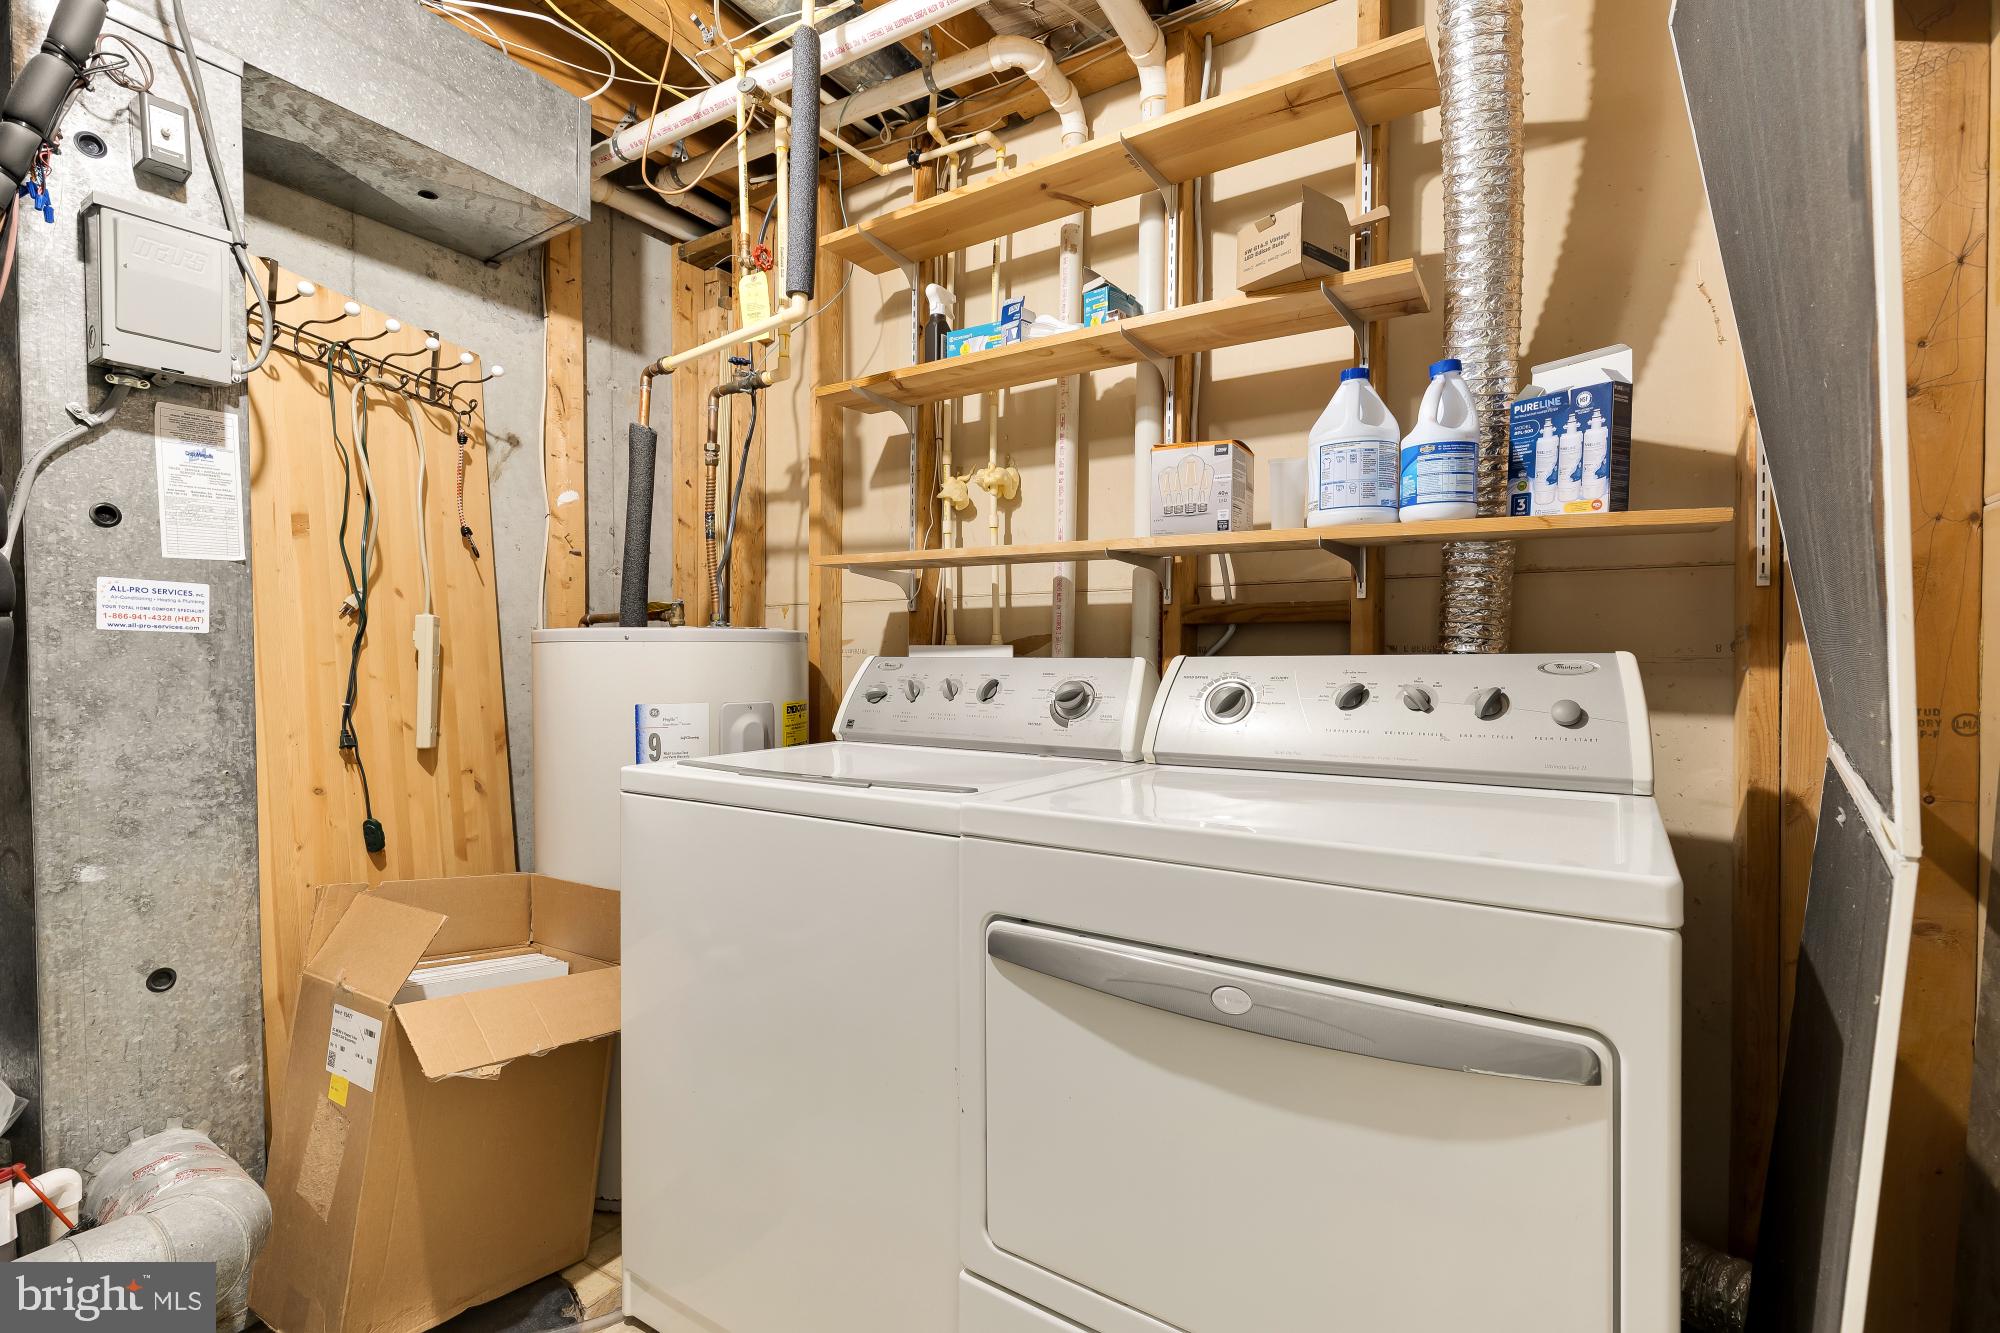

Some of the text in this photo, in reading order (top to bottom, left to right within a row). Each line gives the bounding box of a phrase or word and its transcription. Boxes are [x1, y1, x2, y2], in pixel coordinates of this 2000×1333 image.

[1514, 396, 1562, 414] PURELINE
[1516, 498, 1526, 511] 3
[109, 585, 149, 594] ALL-PRO
[103, 612, 204, 624] 1-866-941-4328 (HEAT)
[107, 621, 200, 631] www.all-pro-services.com
[1555, 663, 1583, 672] Whirlpool
[1917, 708, 1940, 717] TUD
[648, 732, 662, 762] 9
